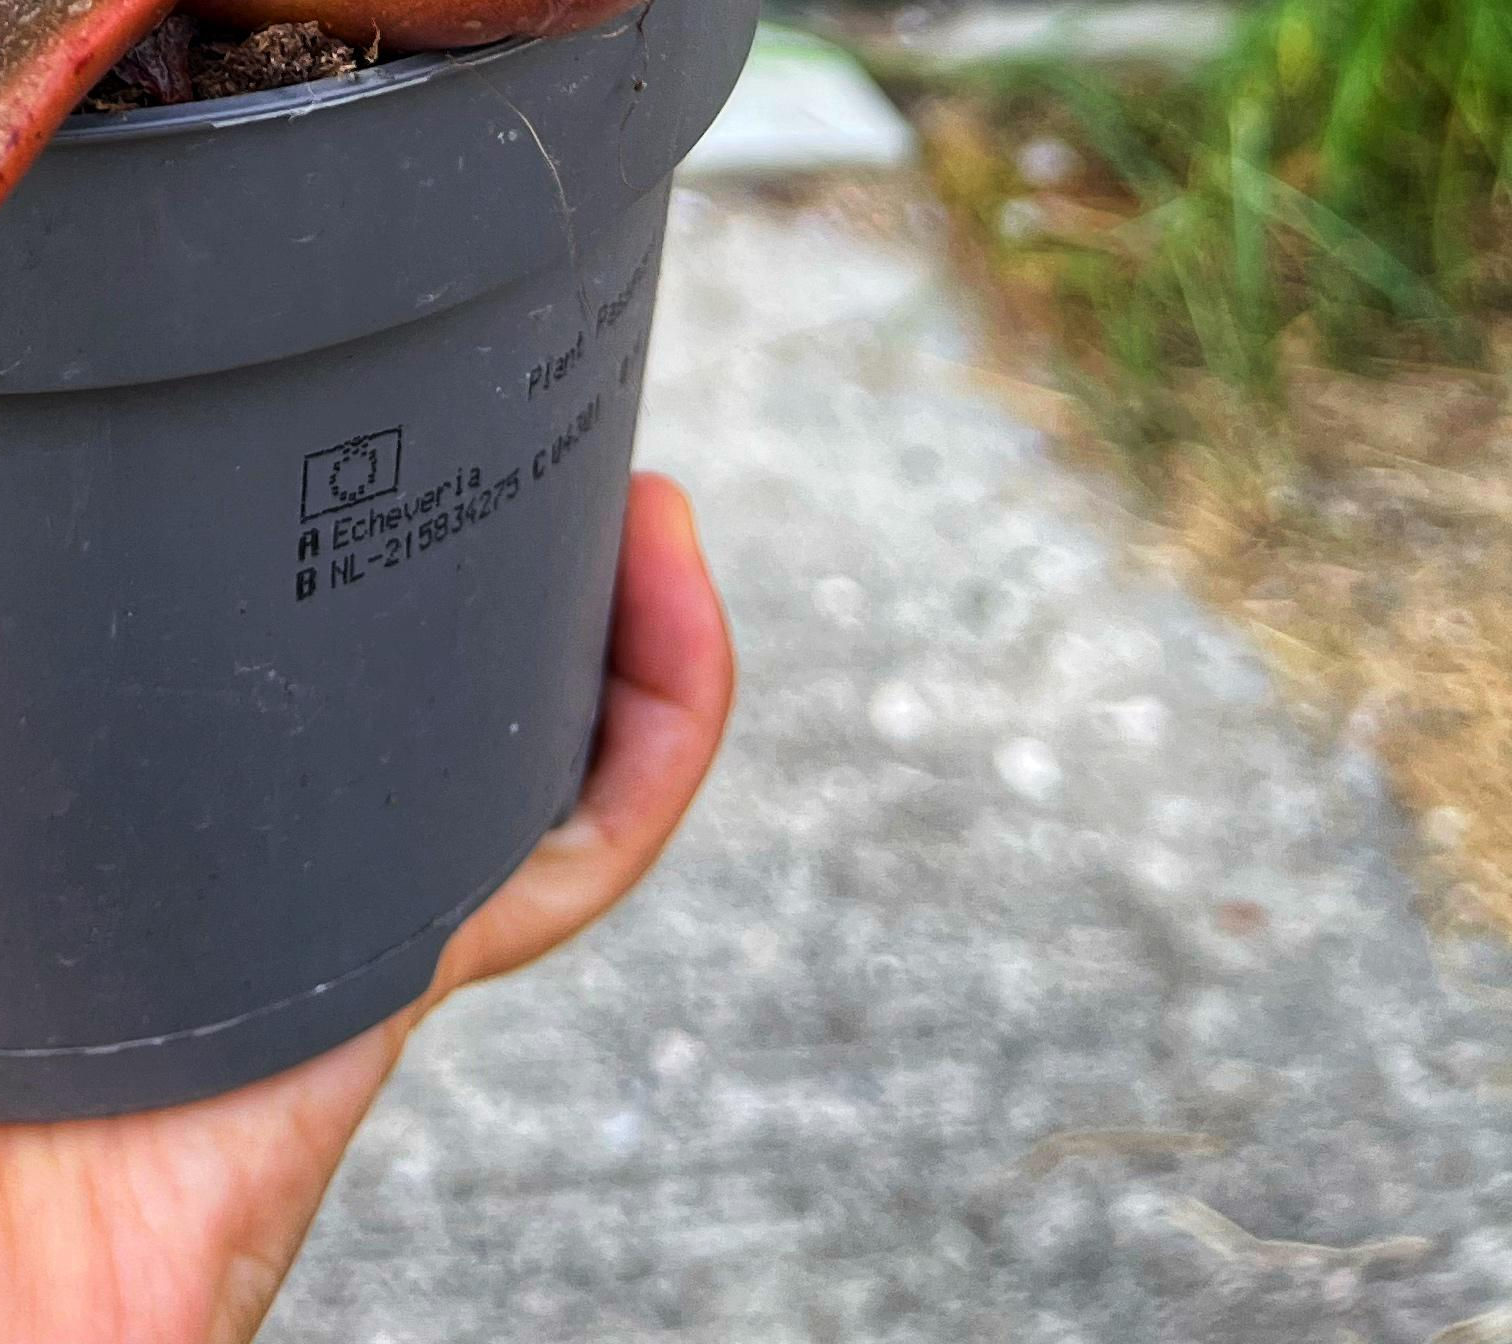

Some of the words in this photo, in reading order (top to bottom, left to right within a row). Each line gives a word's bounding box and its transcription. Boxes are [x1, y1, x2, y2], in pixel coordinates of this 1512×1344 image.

[528, 330, 584, 401] Plant
[295, 566, 317, 602] B
[330, 467, 521, 589] NL-215834275
[531, 448, 547, 481] C
[297, 527, 320, 562] A
[332, 466, 481, 551] Echeveria
